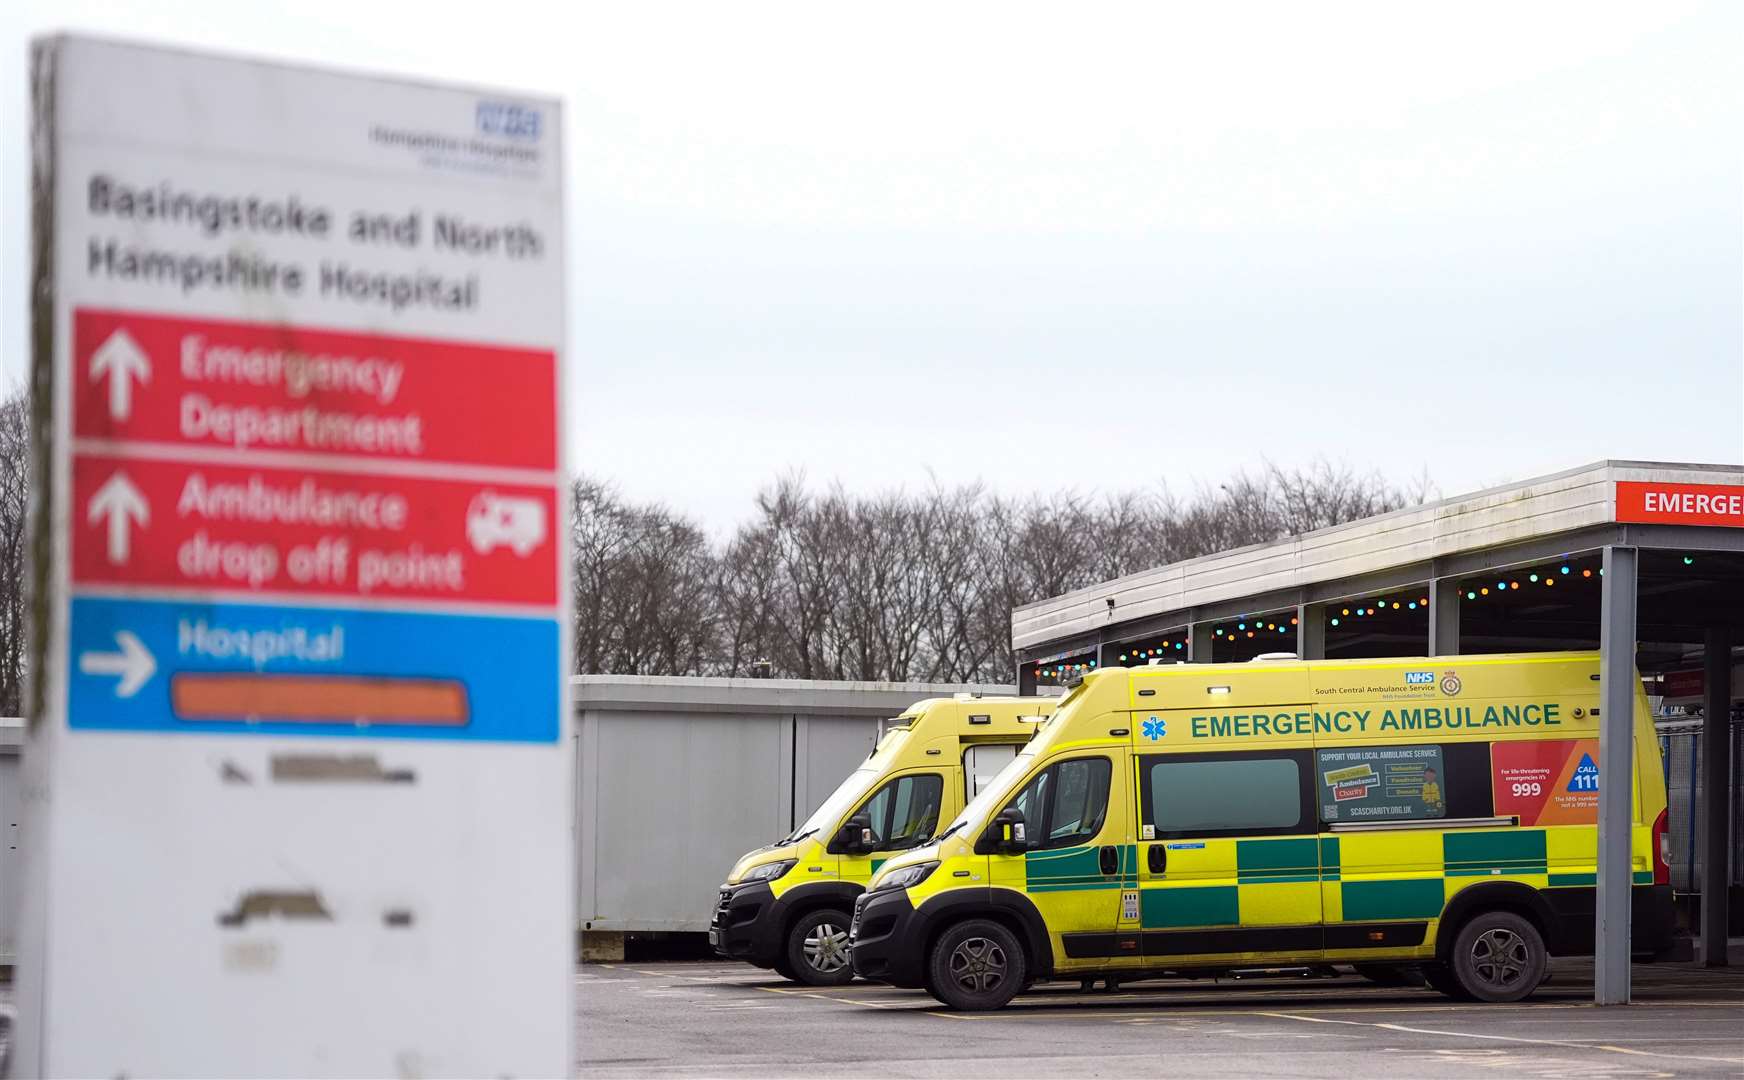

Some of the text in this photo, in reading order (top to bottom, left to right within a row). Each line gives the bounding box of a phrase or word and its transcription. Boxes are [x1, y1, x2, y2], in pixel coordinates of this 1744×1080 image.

[88, 173, 543, 258] Basingstoke and North
[88, 238, 479, 313] Hampshire Hospital
[180, 335, 402, 403] Emergency
[180, 393, 422, 452] Department
[180, 473, 405, 530] Ambulance
[1645, 492, 1744, 515] EMERGE
[178, 530, 463, 593] drop off point
[178, 618, 343, 670] Hospital
[1406, 673, 1434, 683] NHS
[1315, 684, 1435, 695] South Central Ambulance Service
[1191, 704, 1561, 738] EMERGENCY AMBULANCE
[1320, 749, 1437, 762] SUPPORT YOUR LOCAL AMBULANCE SERVICE
[1339, 777, 1377, 788] Ambulance
[1505, 775, 1538, 783] emergencies
[1574, 775, 1599, 789] 111
[1338, 788, 1362, 798] Charity
[1511, 782, 1541, 797] 999
[1350, 806, 1412, 816] SCASCHARITY.ORG.UK
